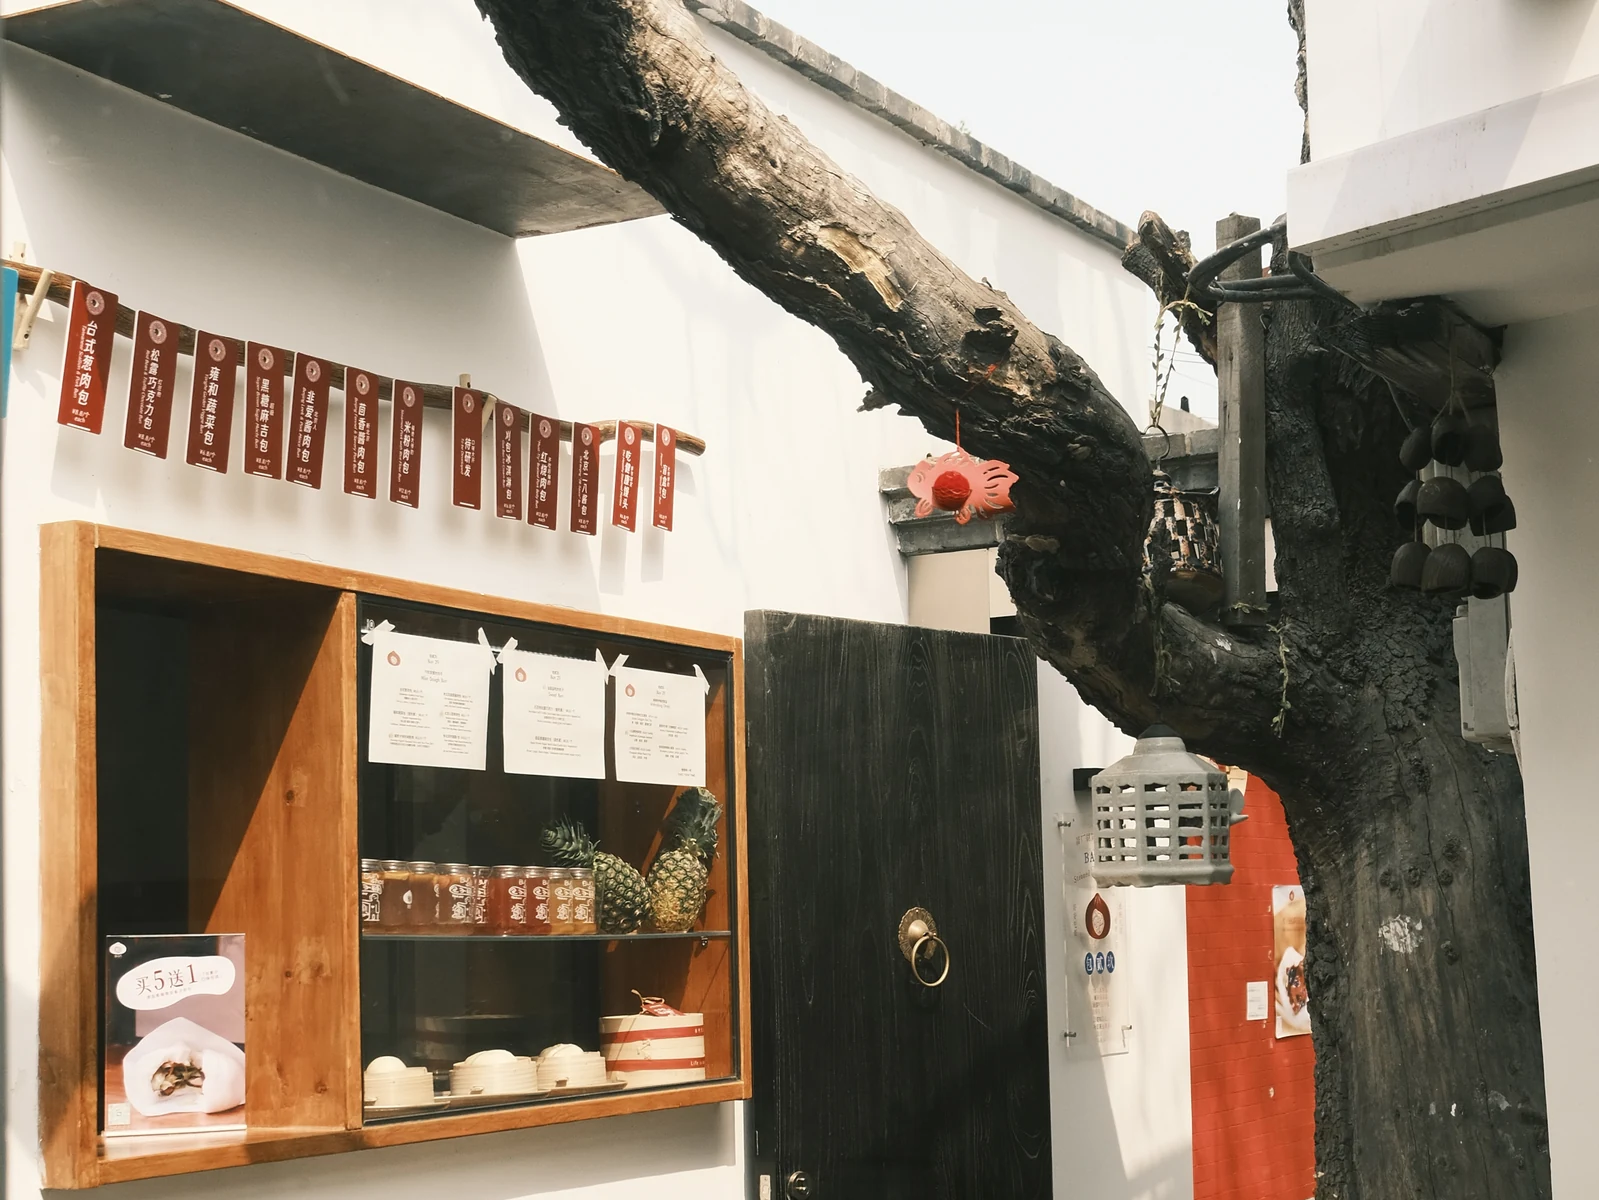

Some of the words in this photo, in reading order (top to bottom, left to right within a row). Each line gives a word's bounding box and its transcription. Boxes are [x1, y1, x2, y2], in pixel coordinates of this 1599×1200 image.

[77, 320, 98, 406] 台式葱肉包
[143, 348, 160, 430] 松露巧克力包
[204, 366, 220, 446] 雍和蔬菜包
[260, 378, 270, 453] 黑糖麻吉包
[302, 390, 315, 462] 韭爱酱肉包
[358, 403, 367, 474] 茴香酱肉包
[402, 421, 412, 474] 米粉肉包
[540, 452, 548, 502] 红烧肉包
[136, 964, 198, 996] 买5送1
